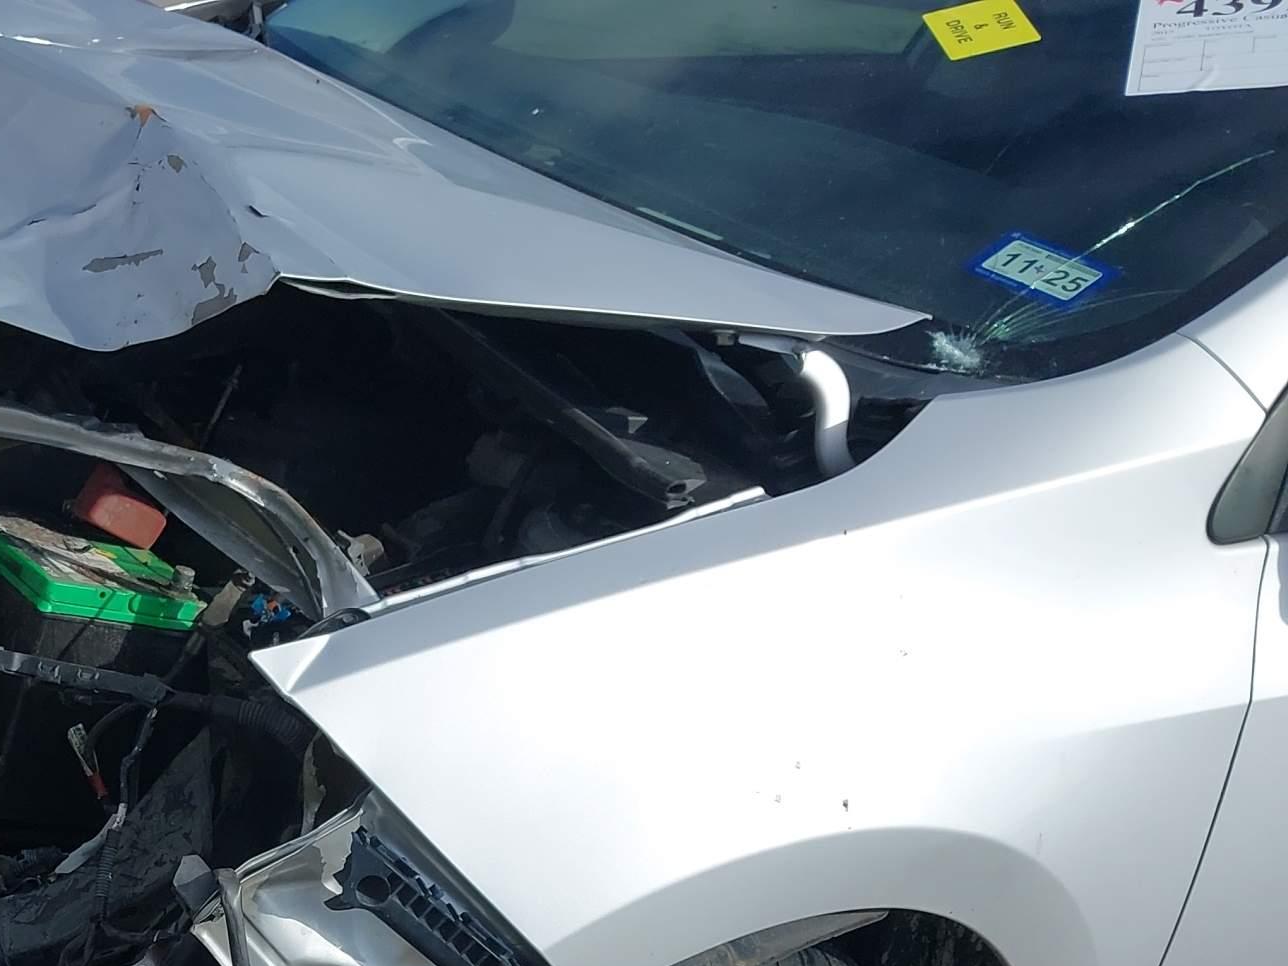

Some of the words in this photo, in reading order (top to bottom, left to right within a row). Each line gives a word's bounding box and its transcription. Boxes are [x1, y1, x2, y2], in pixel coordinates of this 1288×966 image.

[1176, 0, 1288, 18] 439
[974, 22, 989, 31] &
[993, 11, 1016, 30] RUN
[1153, 17, 1238, 29] Progressive
[945, 19, 974, 45] DRIVE
[1001, 253, 1038, 274] 11
[1041, 269, 1089, 292] 25
